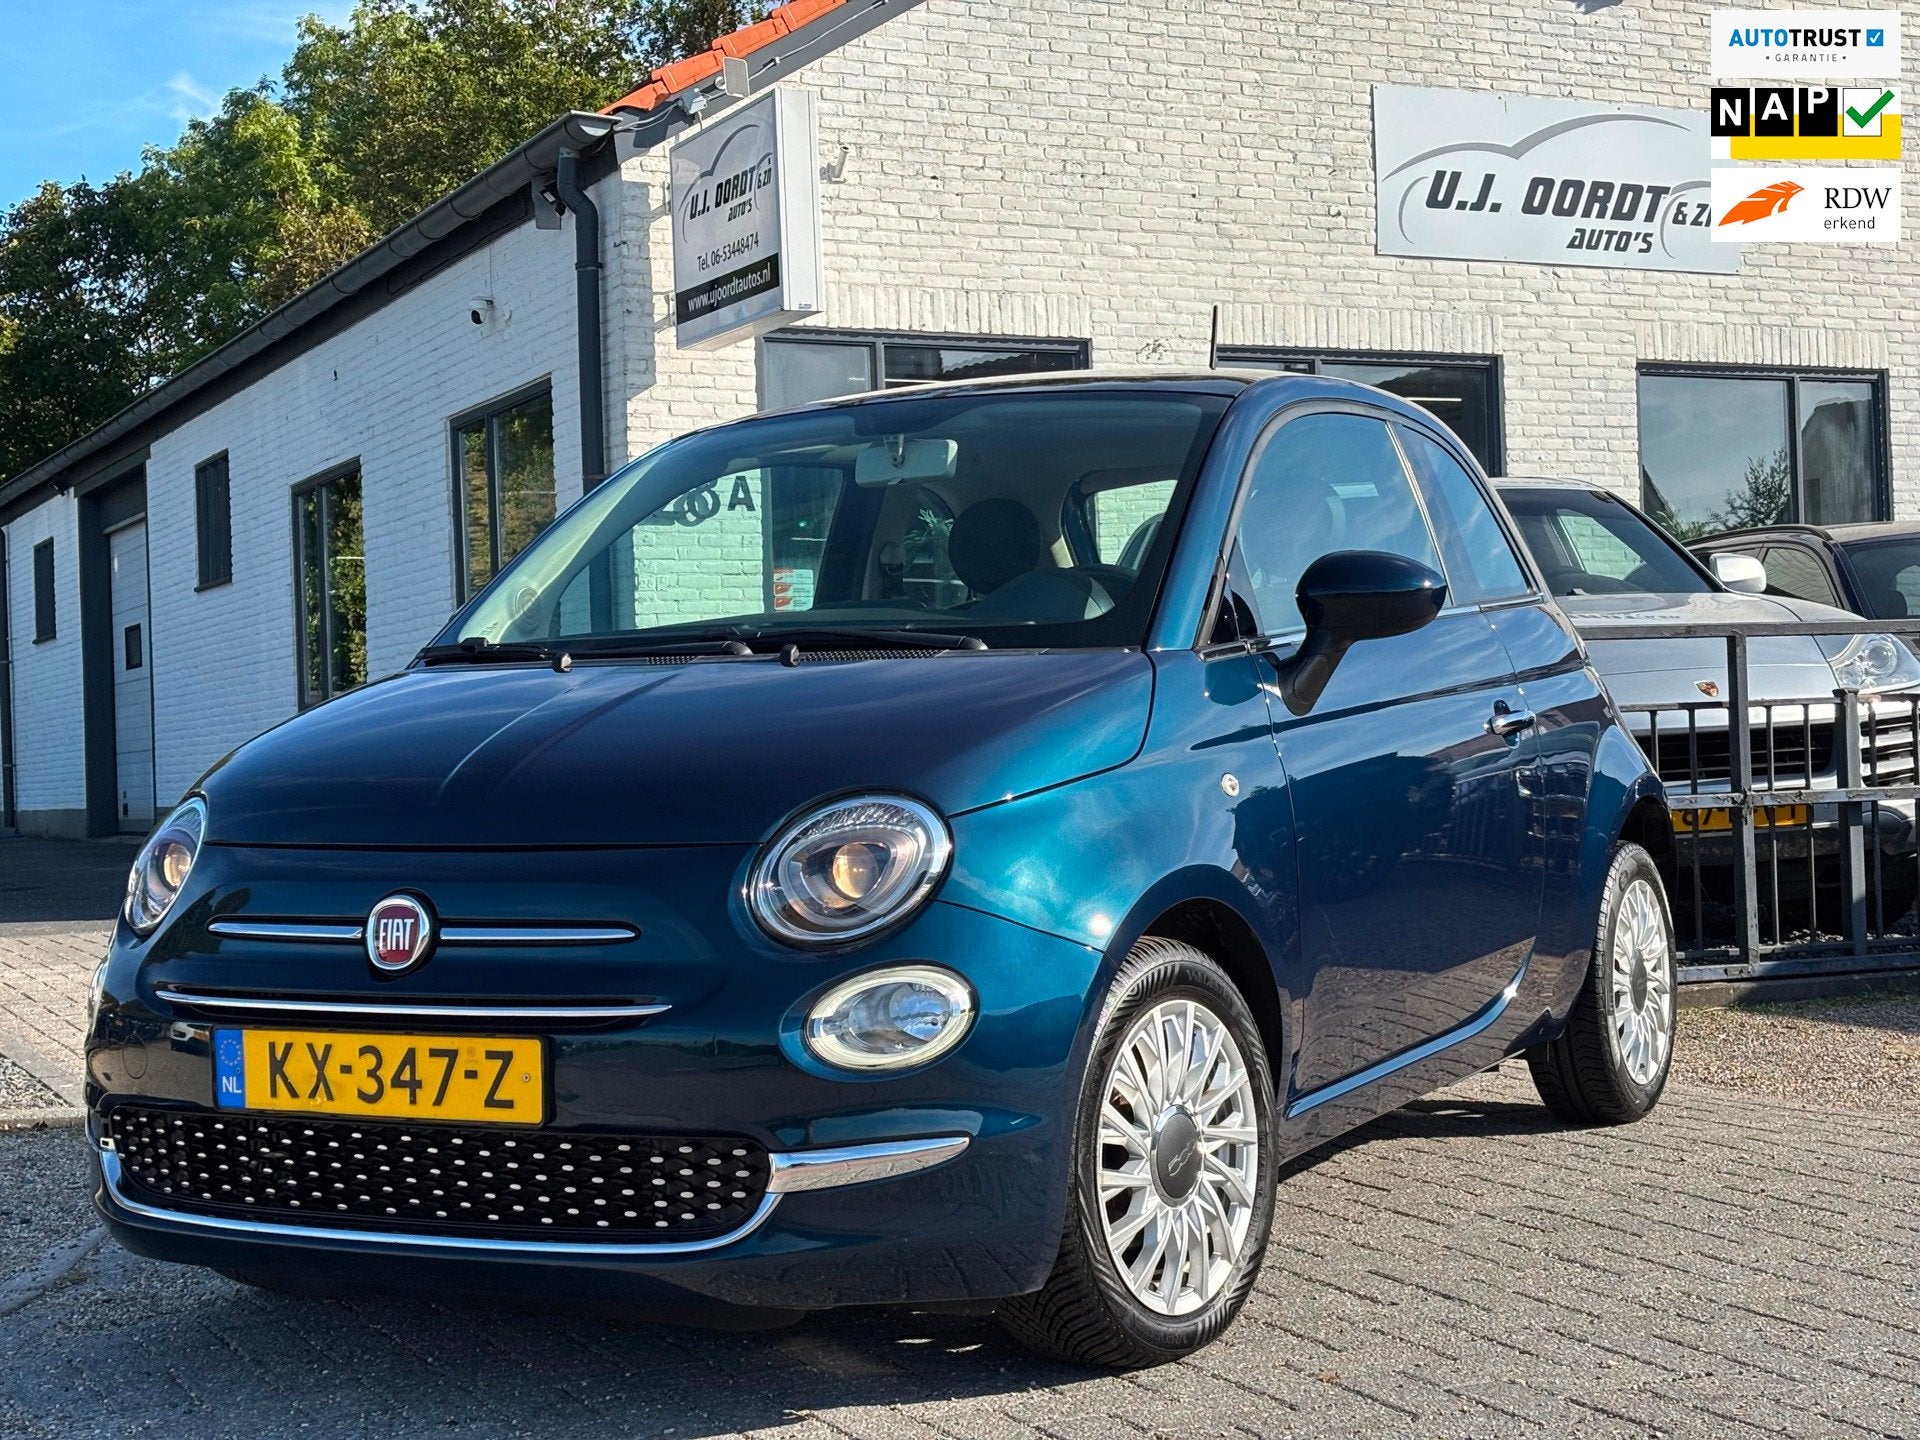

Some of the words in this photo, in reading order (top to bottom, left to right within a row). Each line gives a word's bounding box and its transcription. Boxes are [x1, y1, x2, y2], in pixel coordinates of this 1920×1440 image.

[690, 189, 710, 220] U.J.
[715, 165, 756, 209] OORDT
[1425, 170, 1503, 213] U.J.
[1521, 177, 1671, 222] OORDT
[1672, 202, 1688, 225] &
[697, 252, 710, 272] Tel.
[711, 231, 759, 267] 06-53448474
[1566, 228, 1653, 253] AUTO'S
[687, 261, 771, 312] www.ujoordtautos.nl
[379, 918, 415, 951] FIAT
[222, 1075, 243, 1094] NL
[268, 1041, 514, 1109] KX-347-Z
